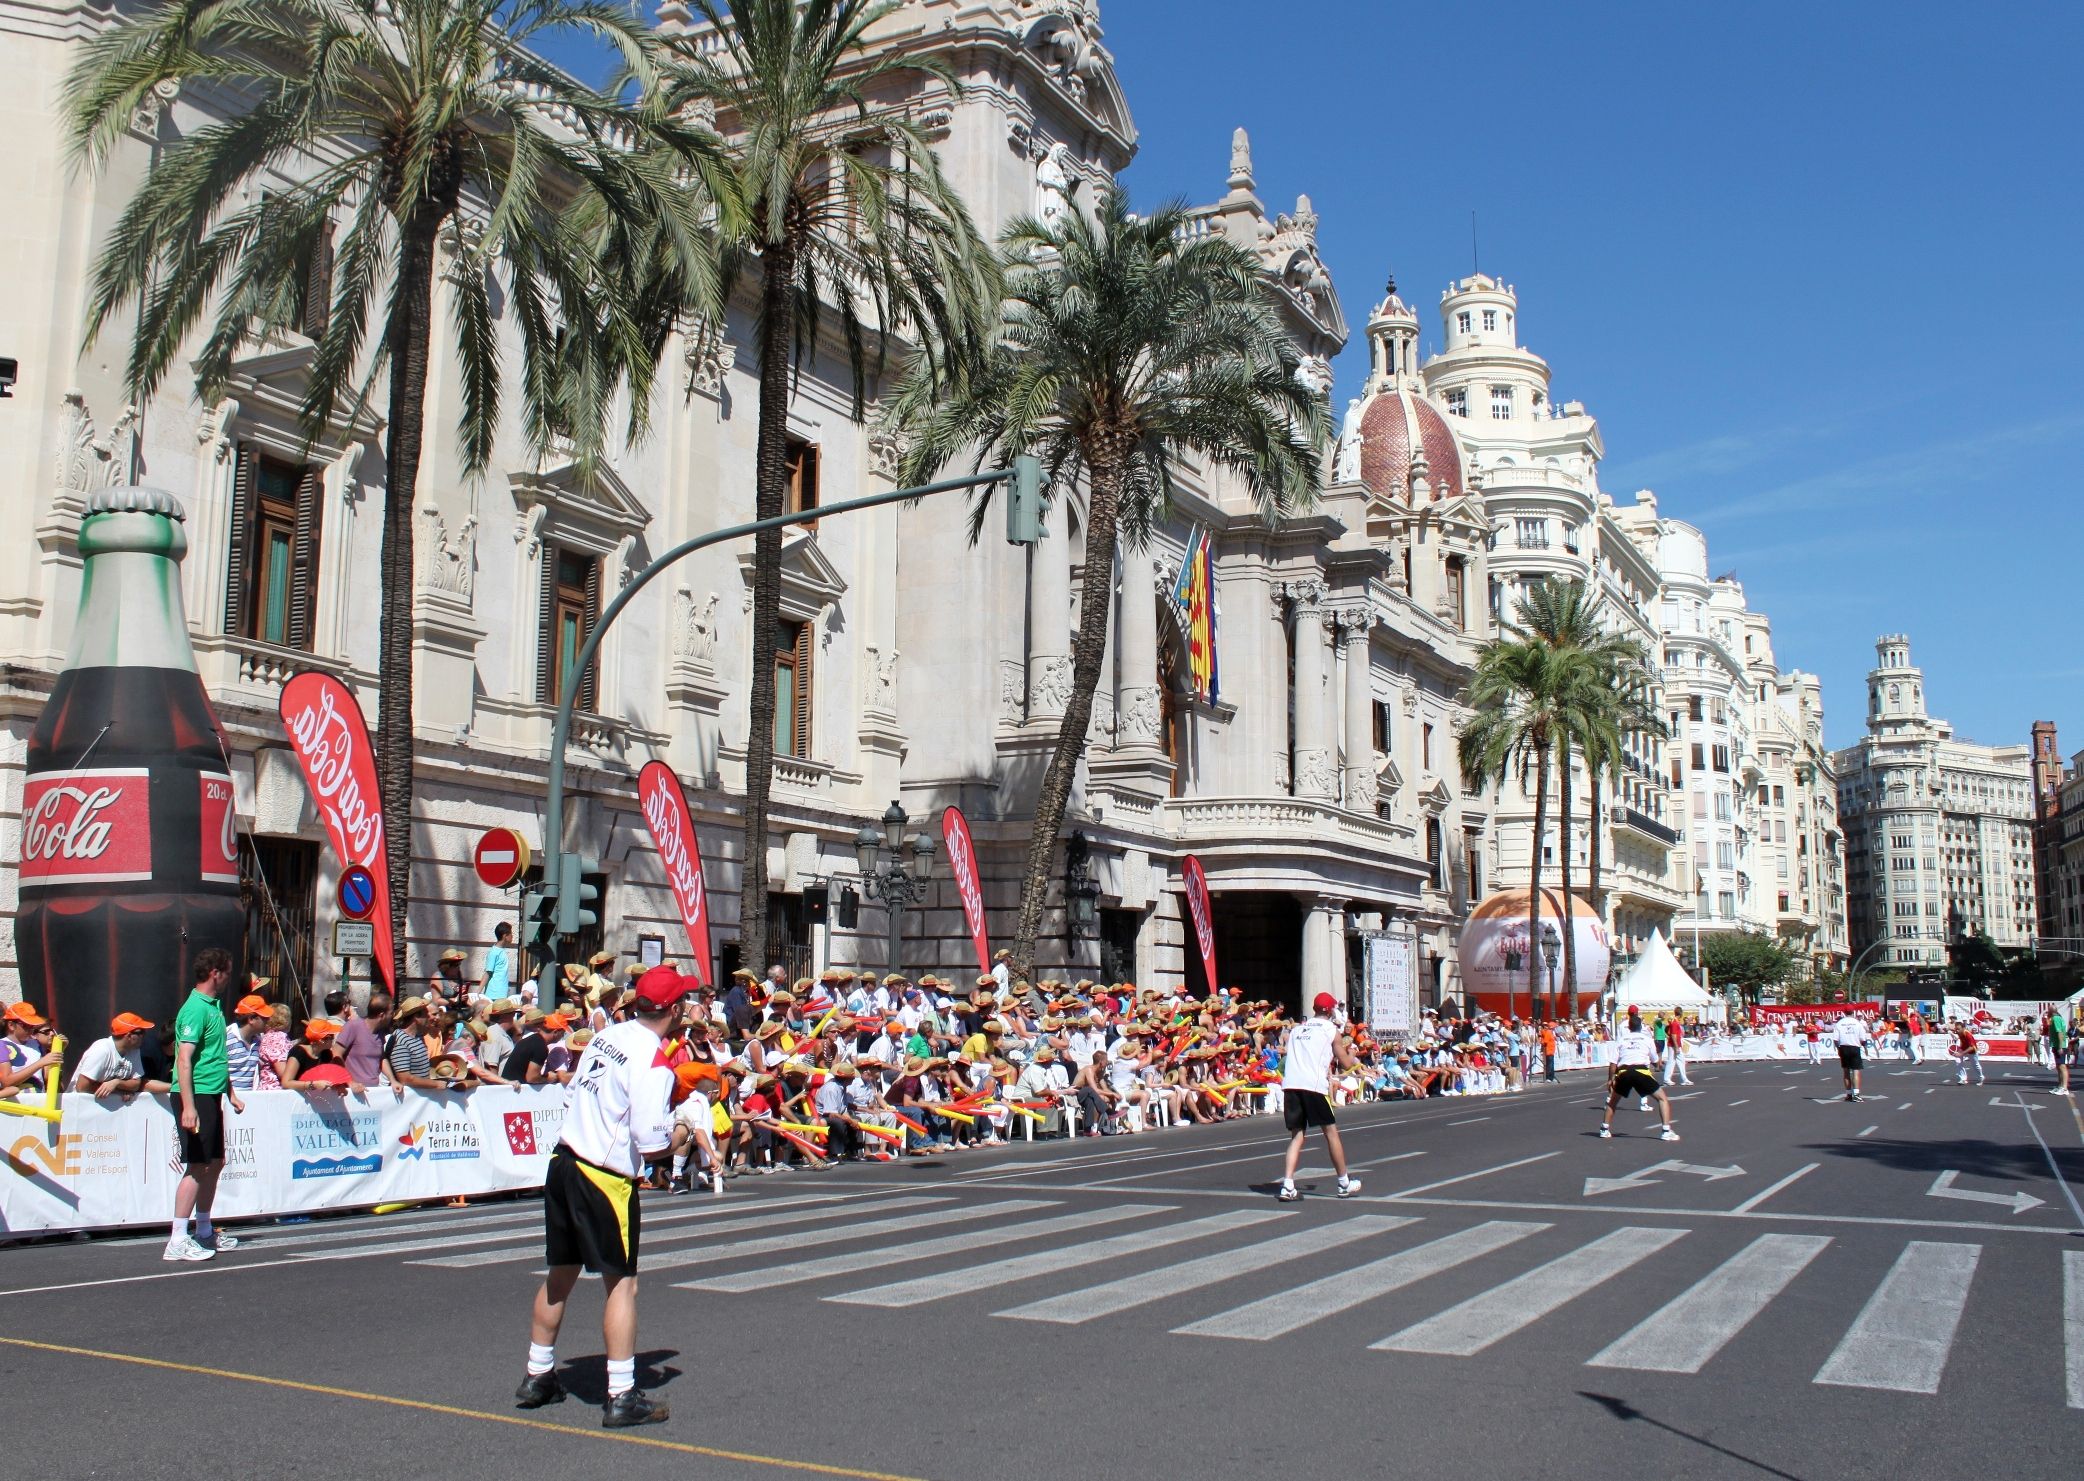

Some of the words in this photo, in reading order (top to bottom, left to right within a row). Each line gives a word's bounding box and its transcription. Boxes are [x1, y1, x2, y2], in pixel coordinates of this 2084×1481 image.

[206, 783, 220, 799] 20
[21, 787, 123, 862] -Cola
[591, 1037, 628, 1066] BELGIUM
[364, 1117, 378, 1126] DE
[533, 1108, 566, 1123] DIPUT
[86, 1134, 118, 1143] Consell
[224, 1128, 255, 1146] ALITAT
[296, 1130, 380, 1150] VALÈNCIA
[428, 1136, 450, 1149] Terra
[453, 1135, 457, 1147] i
[225, 1148, 255, 1165] CIANA
[85, 1166, 96, 1174] de
[97, 1165, 128, 1174] l'Esport
[303, 1167, 334, 1178] Ajuntament
[335, 1163, 374, 1174] d'Ajuntaments
